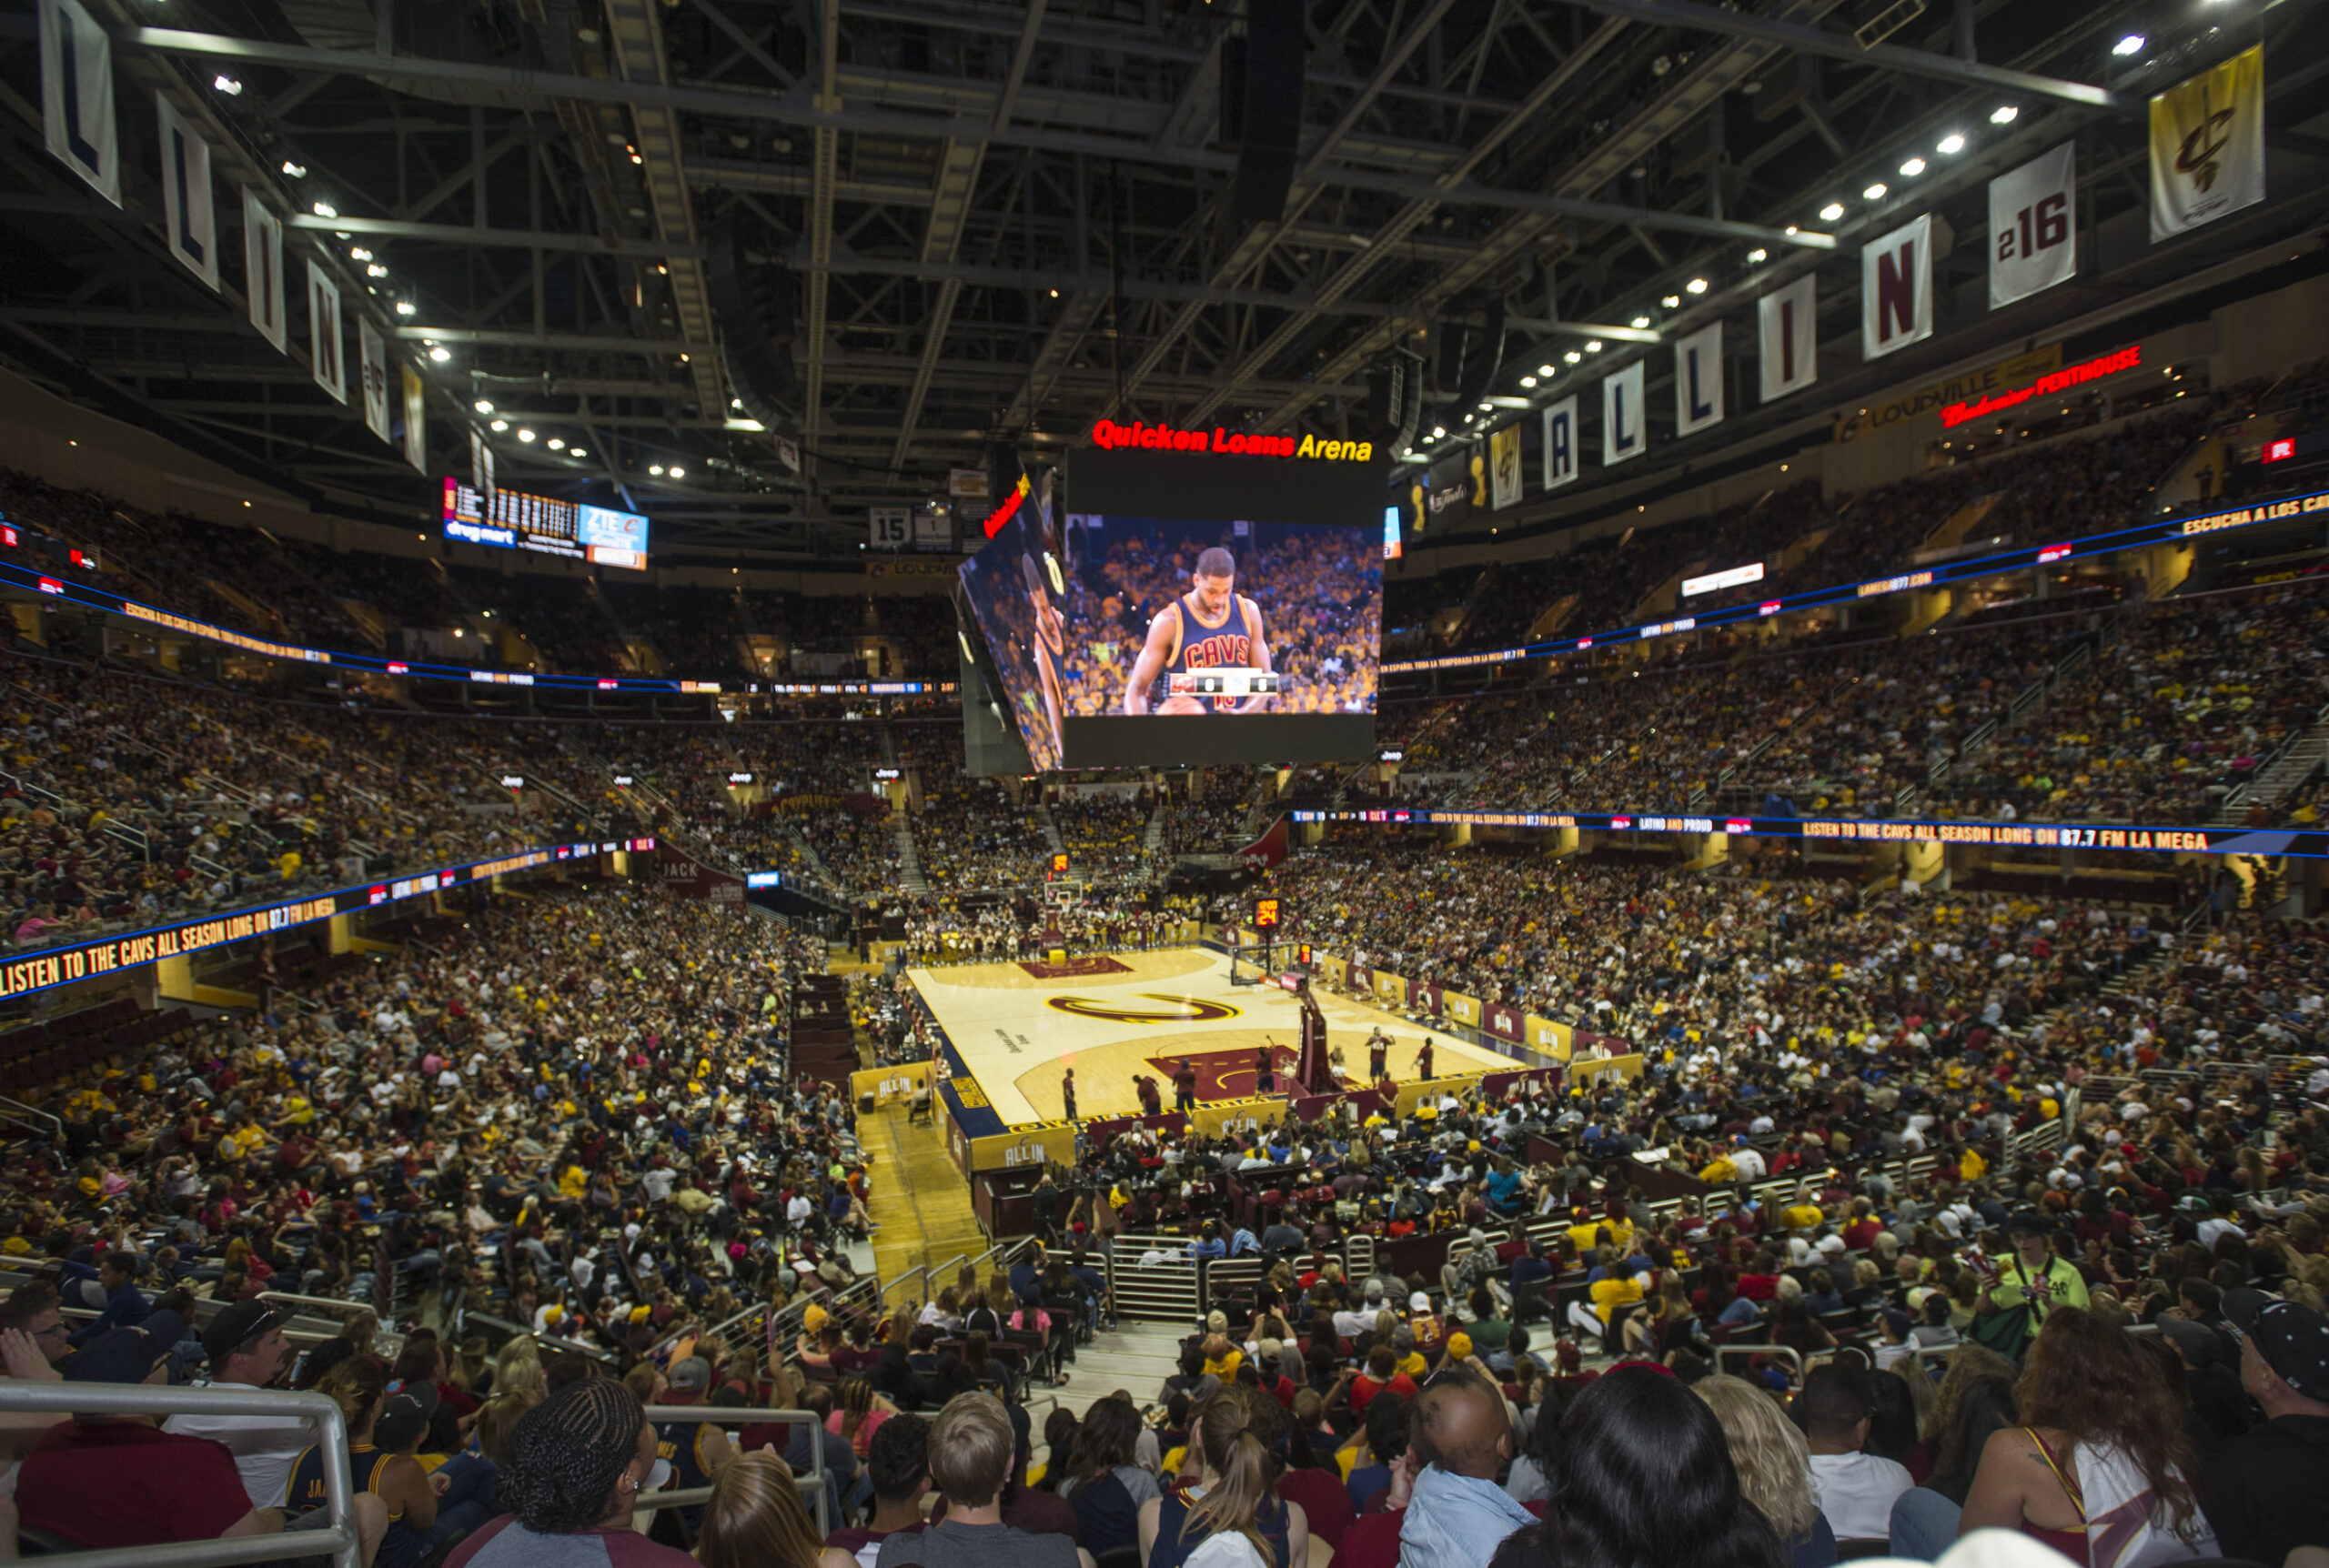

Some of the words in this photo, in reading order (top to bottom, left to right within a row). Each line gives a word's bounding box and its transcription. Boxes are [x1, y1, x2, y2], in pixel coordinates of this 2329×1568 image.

[1879, 238, 1915, 344] N
[1998, 191, 2068, 263] 216
[2035, 345, 2142, 397] PENTHOUSE
[1870, 367, 2000, 428] LOUDVILLE
[1092, 418, 1209, 450] Quicken
[1211, 427, 1287, 457] Loans
[1296, 434, 1373, 462] Arena
[588, 507, 620, 531] ZTE
[878, 518, 905, 541] 15
[2183, 509, 2252, 536] ESCUCHA
[2253, 507, 2266, 522] A
[2269, 500, 2301, 519] LOS
[1185, 634, 1250, 668] CAVS
[1380, 750, 1403, 761] Jeep
[730, 772, 752, 783] Jeep
[876, 769, 900, 778] Jeep
[1639, 818, 1666, 830] LATINO
[1667, 818, 1683, 830] AND
[1683, 819, 1713, 832] PROUD
[1802, 822, 1840, 837] LISTEN
[1841, 822, 1856, 838] TO
[1858, 823, 1880, 839] THE
[1881, 824, 1913, 839] CAVS
[1914, 825, 1937, 840] ALL
[1939, 826, 1992, 842] SEASON
[1992, 827, 2032, 844] LONG
[2033, 828, 2058, 845] ON
[2059, 829, 2096, 847] 87.7
[2100, 829, 2126, 848] FM
[2129, 830, 2152, 849] LA
[2155, 831, 2209, 850] MEGA
[663, 862, 698, 878] JACK
[1258, 910, 1276, 925] 24
[0, 956, 59, 997] LISTEN
[63, 951, 85, 980] TO
[86, 943, 118, 974] THE
[119, 936, 156, 966] CAVS
[156, 930, 180, 957] ALL
[181, 920, 226, 951] SEASON
[226, 914, 254, 940] LONG
[254, 910, 268, 934] ON
[314, 897, 336, 920] MEGA
[879, 1079, 899, 1099] ALL
[899, 1076, 911, 1093] IN
[1005, 1146, 1031, 1168] ALL
[1032, 1143, 1045, 1163] IN
